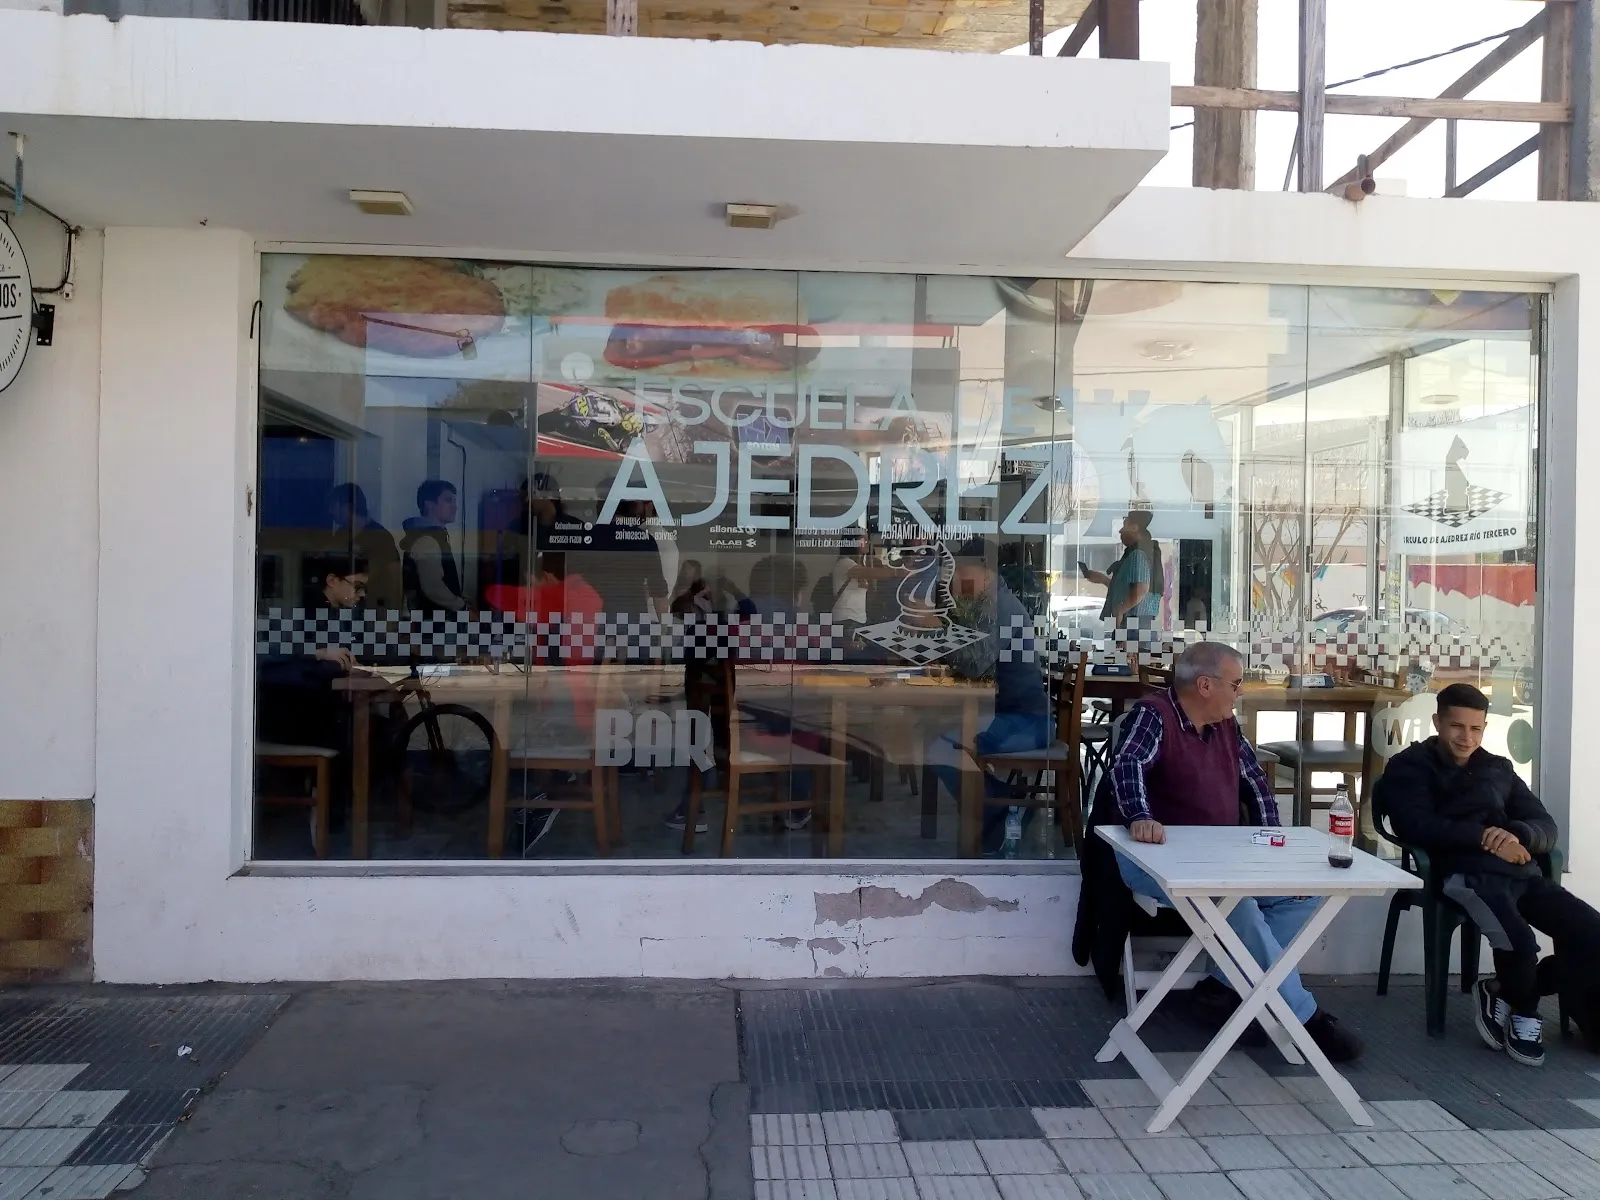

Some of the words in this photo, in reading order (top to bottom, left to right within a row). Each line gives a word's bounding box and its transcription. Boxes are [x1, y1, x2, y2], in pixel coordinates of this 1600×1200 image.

[634, 376, 918, 431] ESCUELA
[596, 436, 1065, 535] AJEDREZ
[1482, 527, 1517, 540] TERCERO
[594, 708, 717, 773] BAR
